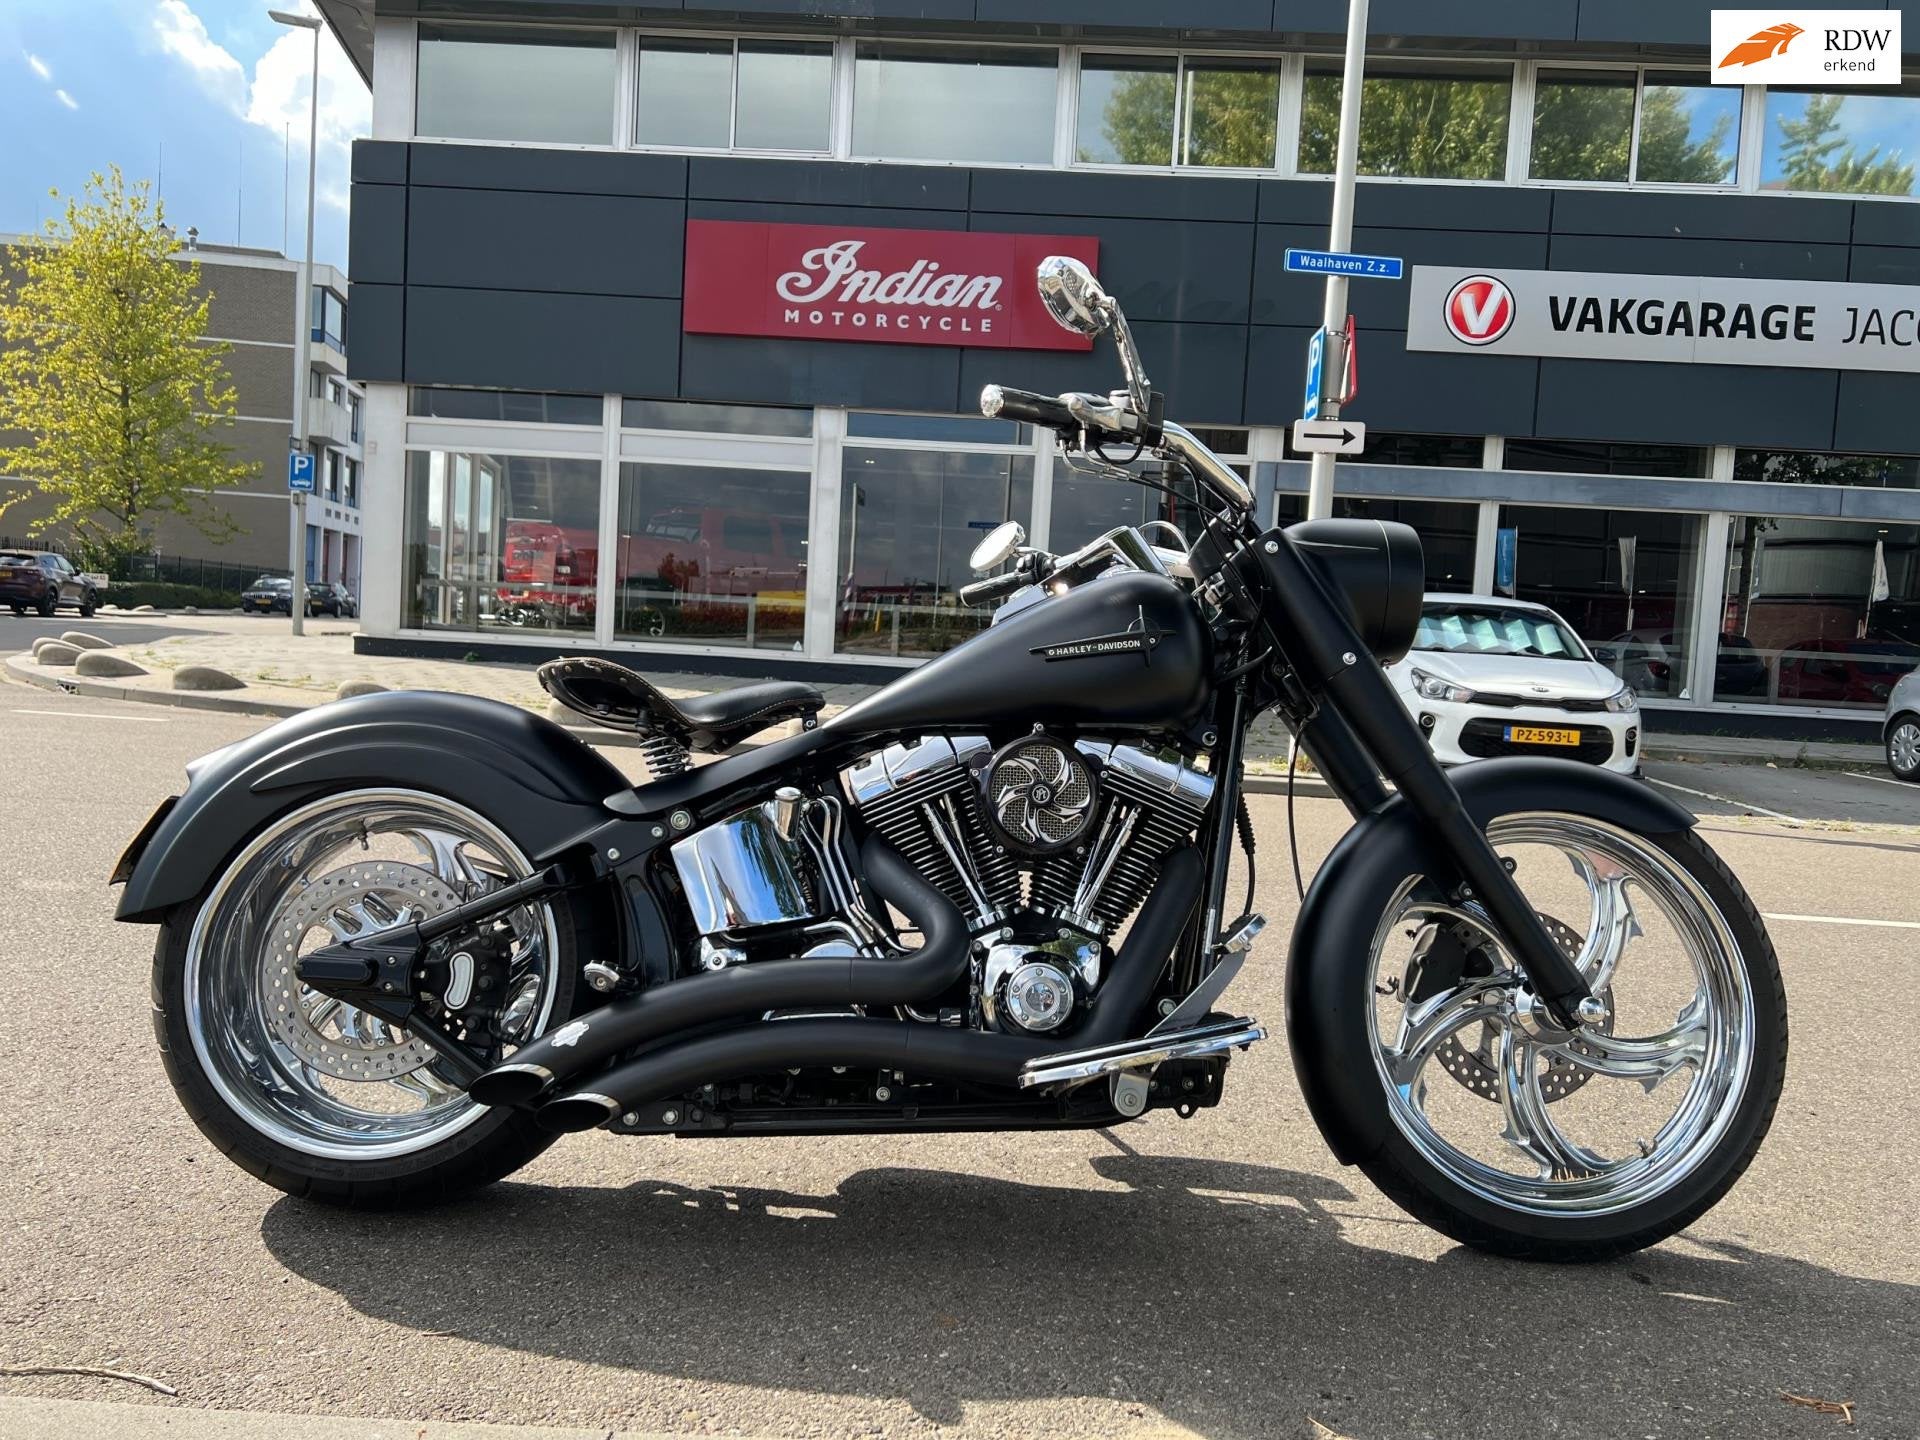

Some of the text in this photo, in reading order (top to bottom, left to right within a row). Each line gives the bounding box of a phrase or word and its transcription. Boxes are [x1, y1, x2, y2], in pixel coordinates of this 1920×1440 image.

[1300, 255, 1362, 272] Waalhaven
[775, 239, 1003, 311] Indian
[784, 308, 992, 333] MOTORCYCLE
[1549, 295, 1816, 341] VAKGARAGE
[1841, 306, 1920, 346] JAC
[294, 456, 309, 475] P
[1056, 639, 1141, 656] HARLEY-DAVIDSON
[1516, 728, 1575, 744] PZ-593-L
